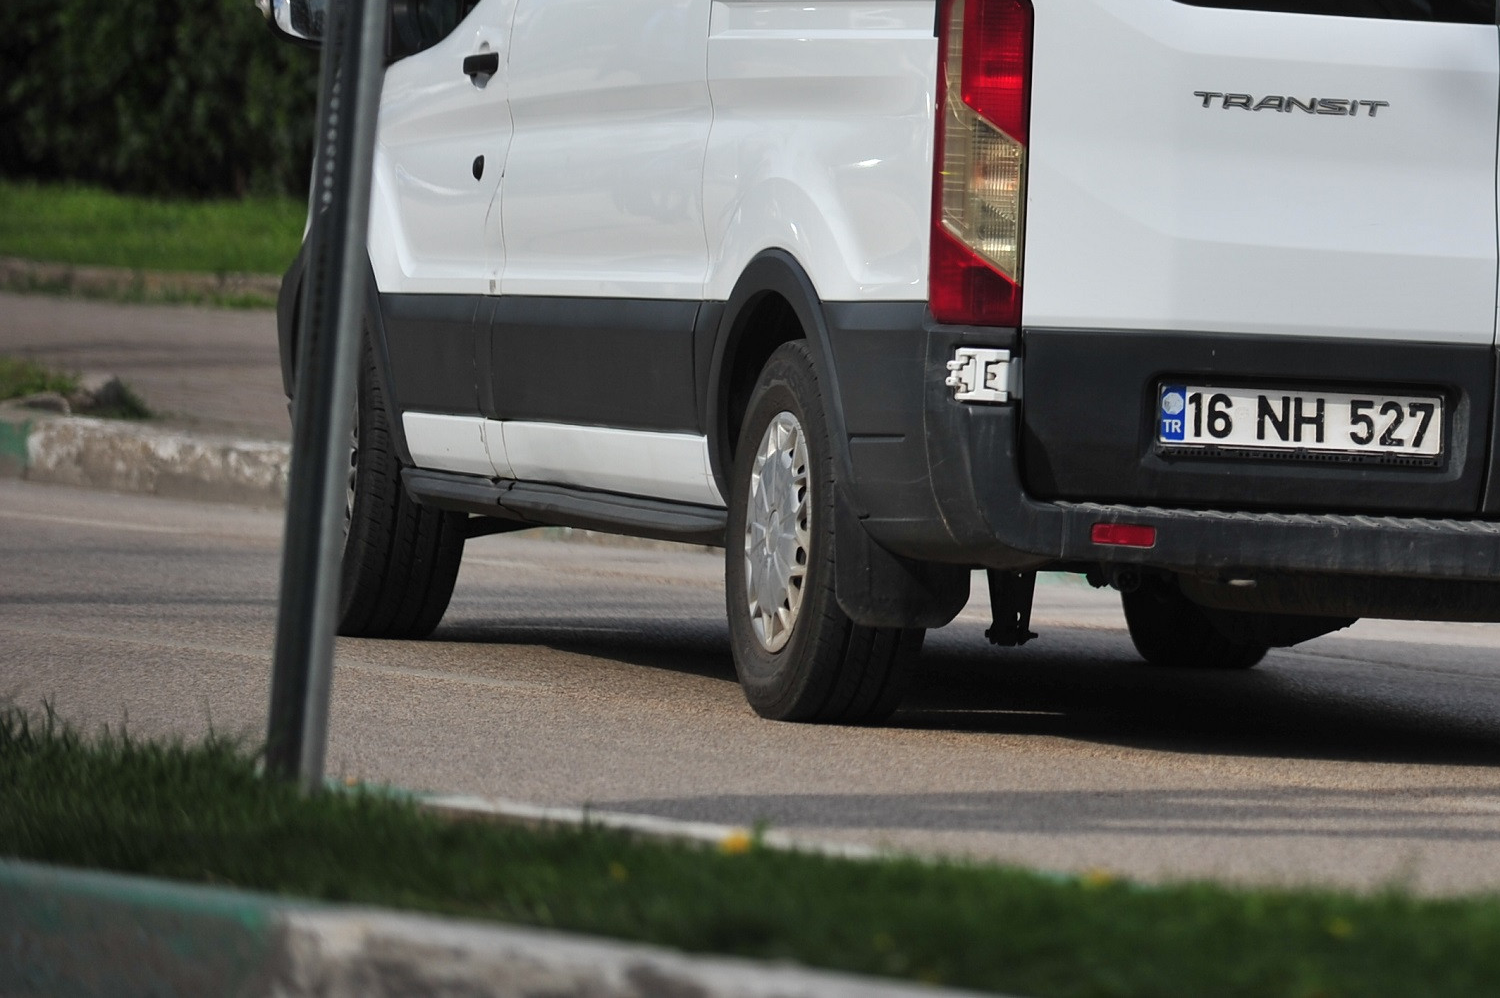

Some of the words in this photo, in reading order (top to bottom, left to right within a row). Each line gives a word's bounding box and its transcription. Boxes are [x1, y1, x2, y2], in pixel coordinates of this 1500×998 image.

[1193, 90, 1391, 118] TRANSIT
[1162, 418, 1182, 433] TR
[1188, 392, 1234, 439] 16
[1256, 394, 1326, 443] NH
[1349, 399, 1435, 448] 527
